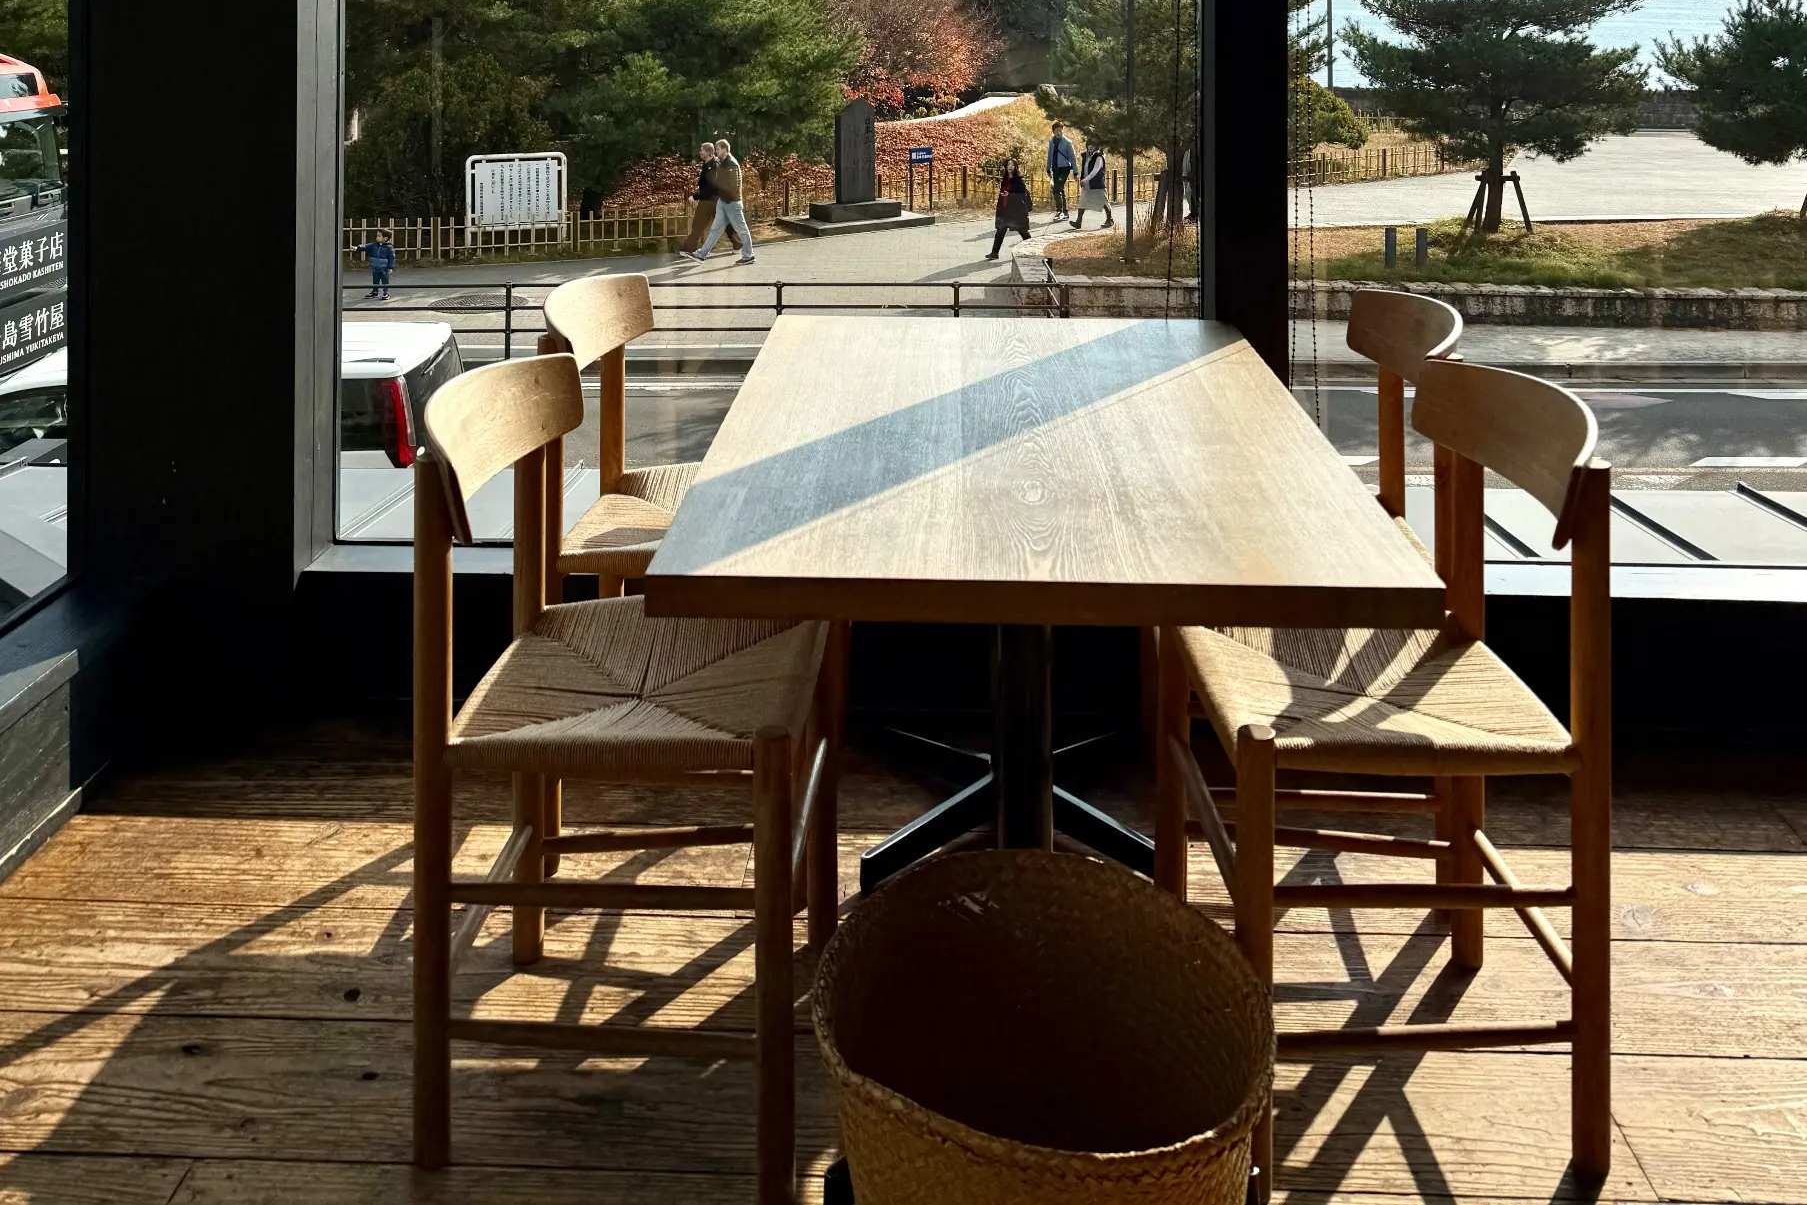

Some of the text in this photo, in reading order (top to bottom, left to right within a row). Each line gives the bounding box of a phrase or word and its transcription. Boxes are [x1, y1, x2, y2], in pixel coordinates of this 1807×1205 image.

[0, 231, 64, 275] 堂菓子店
[0, 261, 64, 290] SHOKADO KASHITEN
[0, 301, 64, 350] 島雪竹屋
[25, 331, 64, 354] YUKITAKEYA
